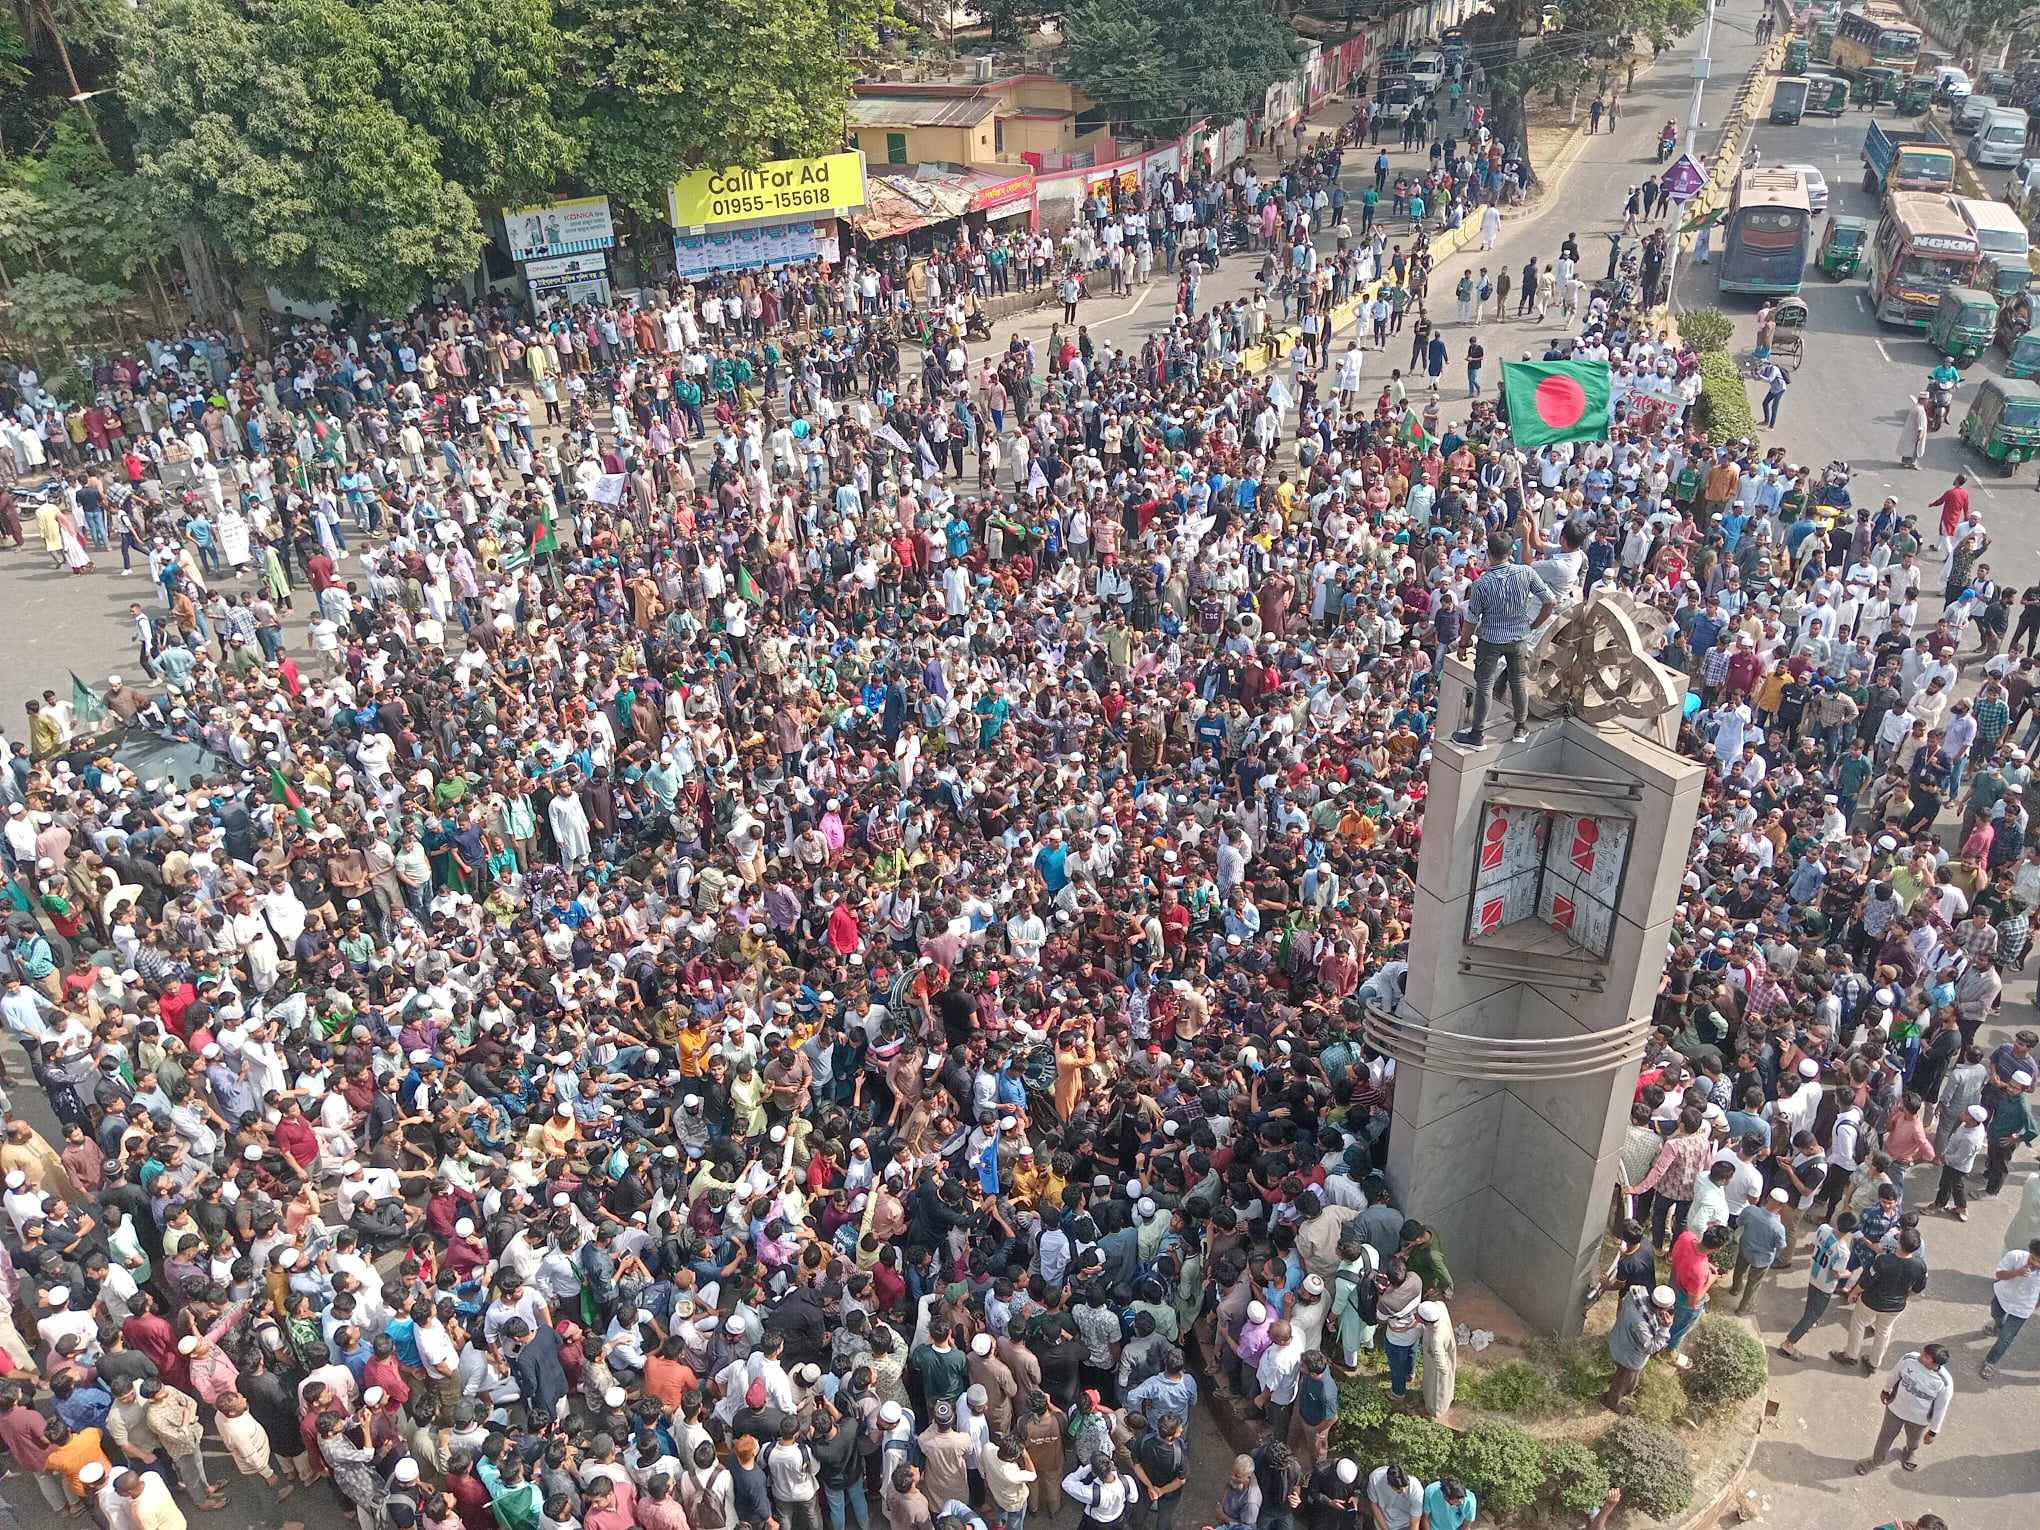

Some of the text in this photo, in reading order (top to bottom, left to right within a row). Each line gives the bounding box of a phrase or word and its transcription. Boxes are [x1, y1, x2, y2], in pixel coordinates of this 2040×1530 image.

[708, 162, 829, 195] Call For Ad
[713, 188, 830, 216] 01955-155618
